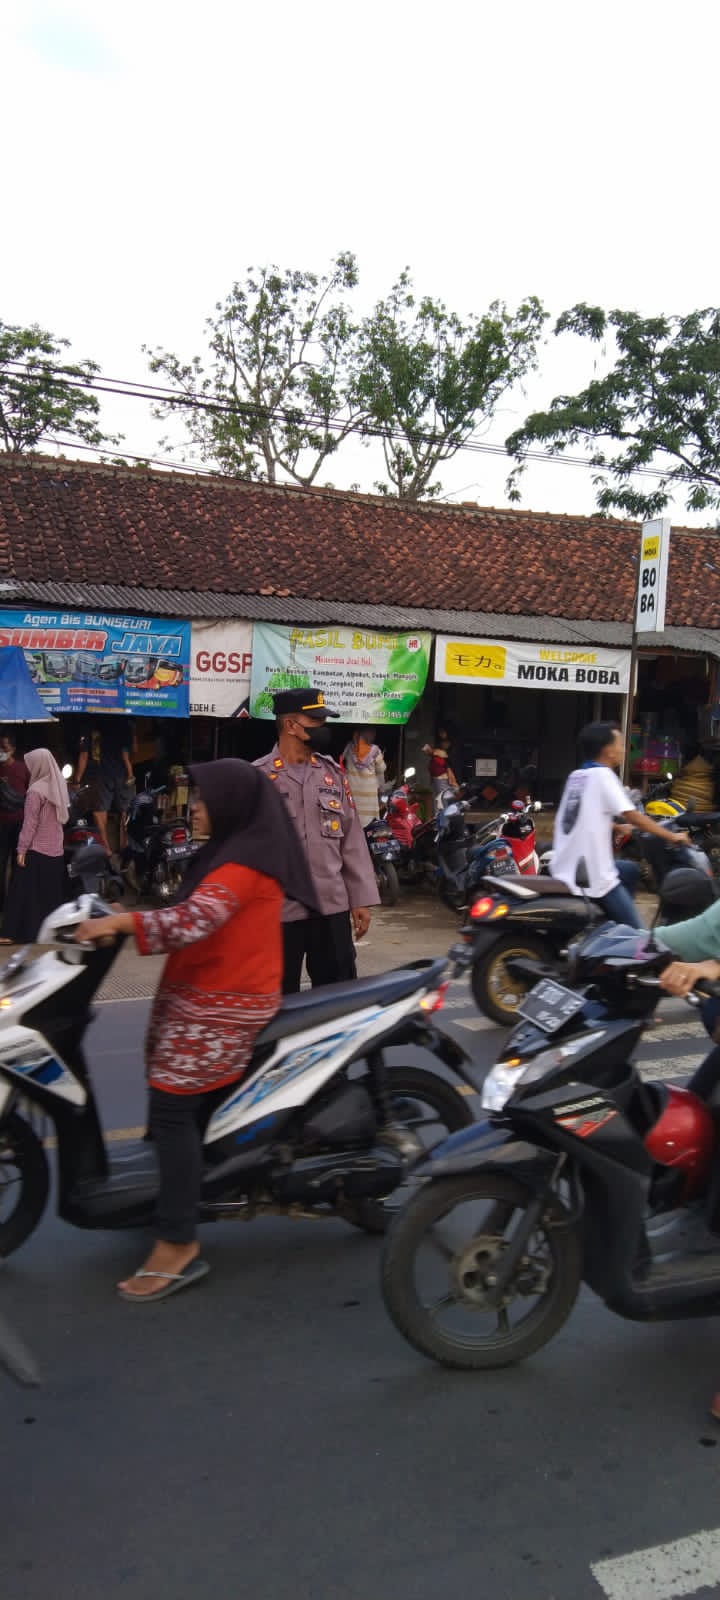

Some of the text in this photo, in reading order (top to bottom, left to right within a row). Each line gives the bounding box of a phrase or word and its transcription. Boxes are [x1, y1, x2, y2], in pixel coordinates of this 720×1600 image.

[642, 567, 657, 588] BO
[640, 592, 655, 613] BA
[24, 614, 57, 627] Agen
[60, 616, 81, 626] Bis
[0, 628, 182, 656] SUMBER JAYA
[289, 628, 398, 650] HASIL BUMI
[539, 649, 598, 664] WELCOME
[517, 664, 621, 686] MOKA BOBA
